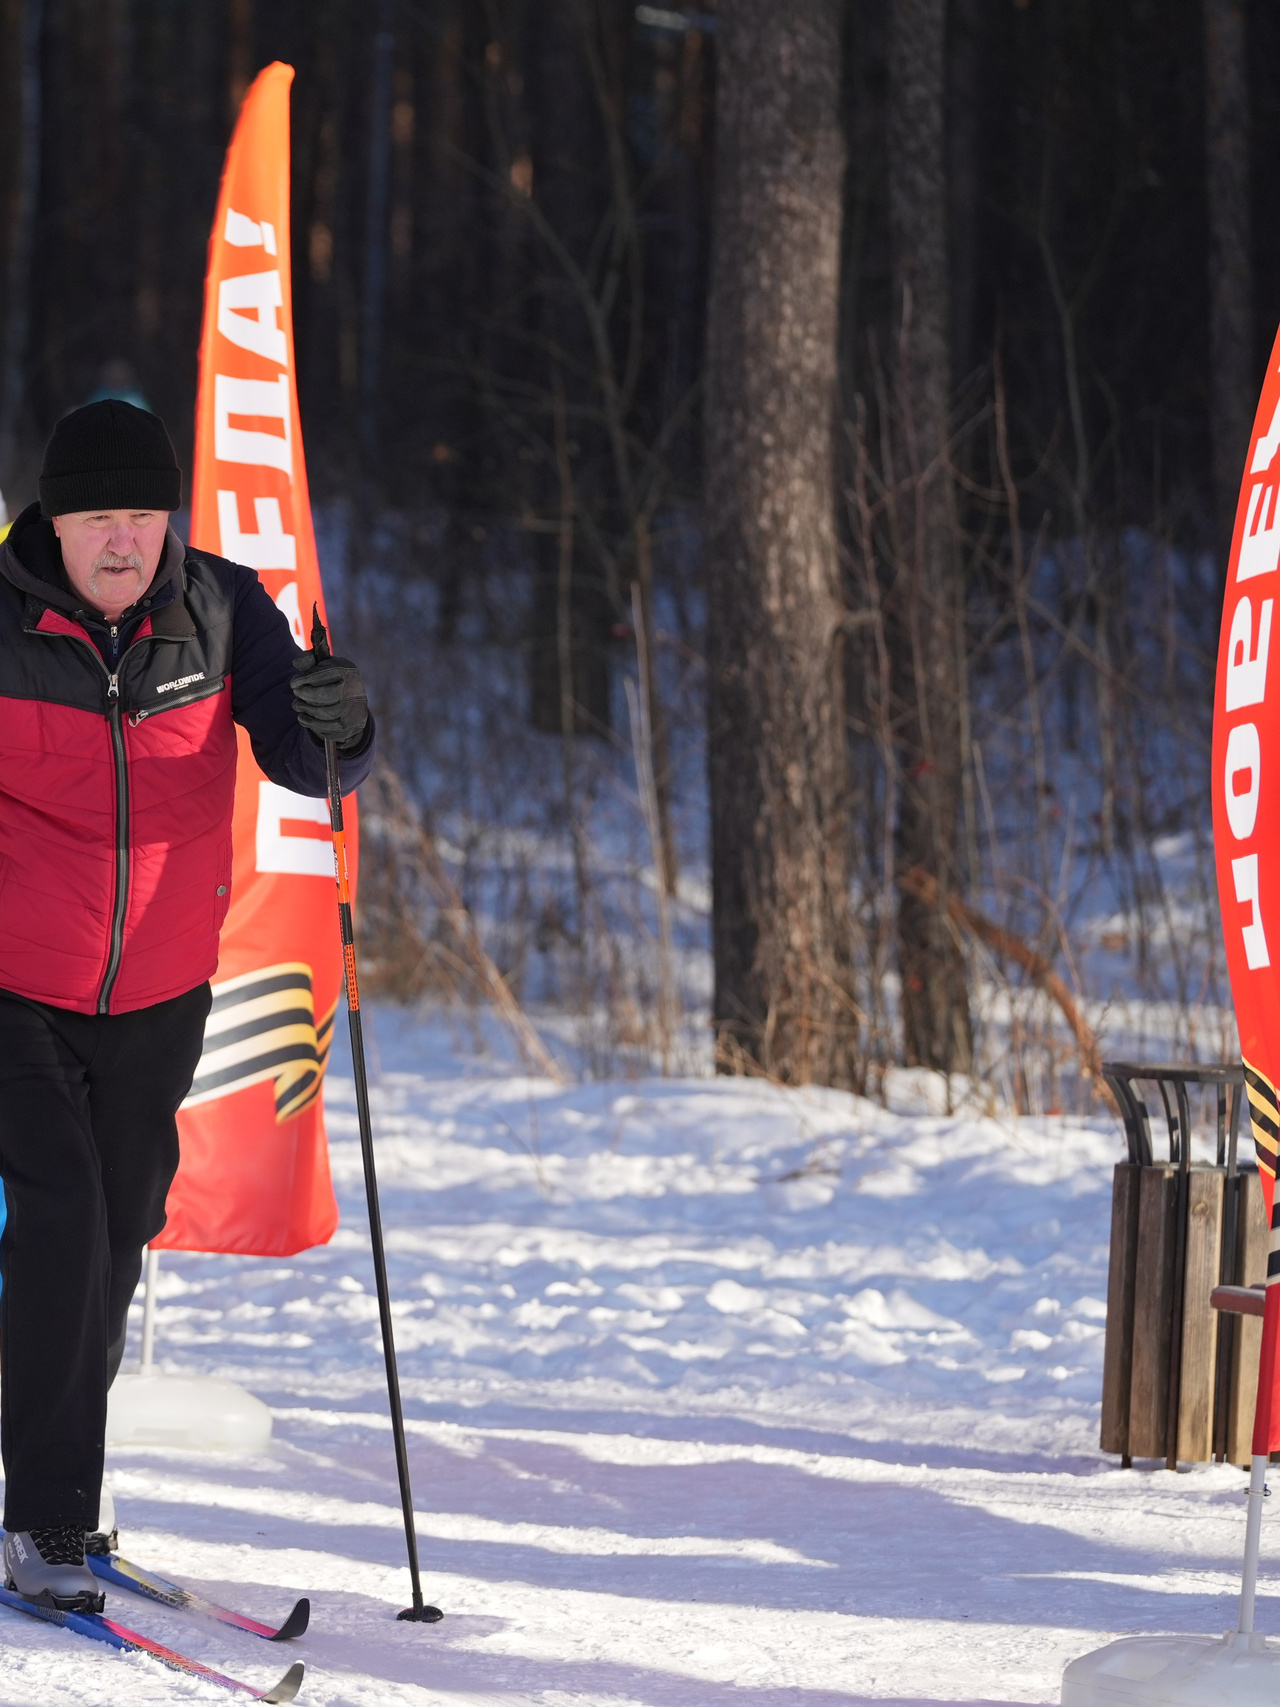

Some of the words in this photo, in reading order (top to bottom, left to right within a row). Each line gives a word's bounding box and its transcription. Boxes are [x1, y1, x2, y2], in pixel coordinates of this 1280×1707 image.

[217, 208, 337, 878] ПЕДА!
[156, 672, 205, 694] WORLDWIDE
[13, 1532, 29, 1565] TREK
